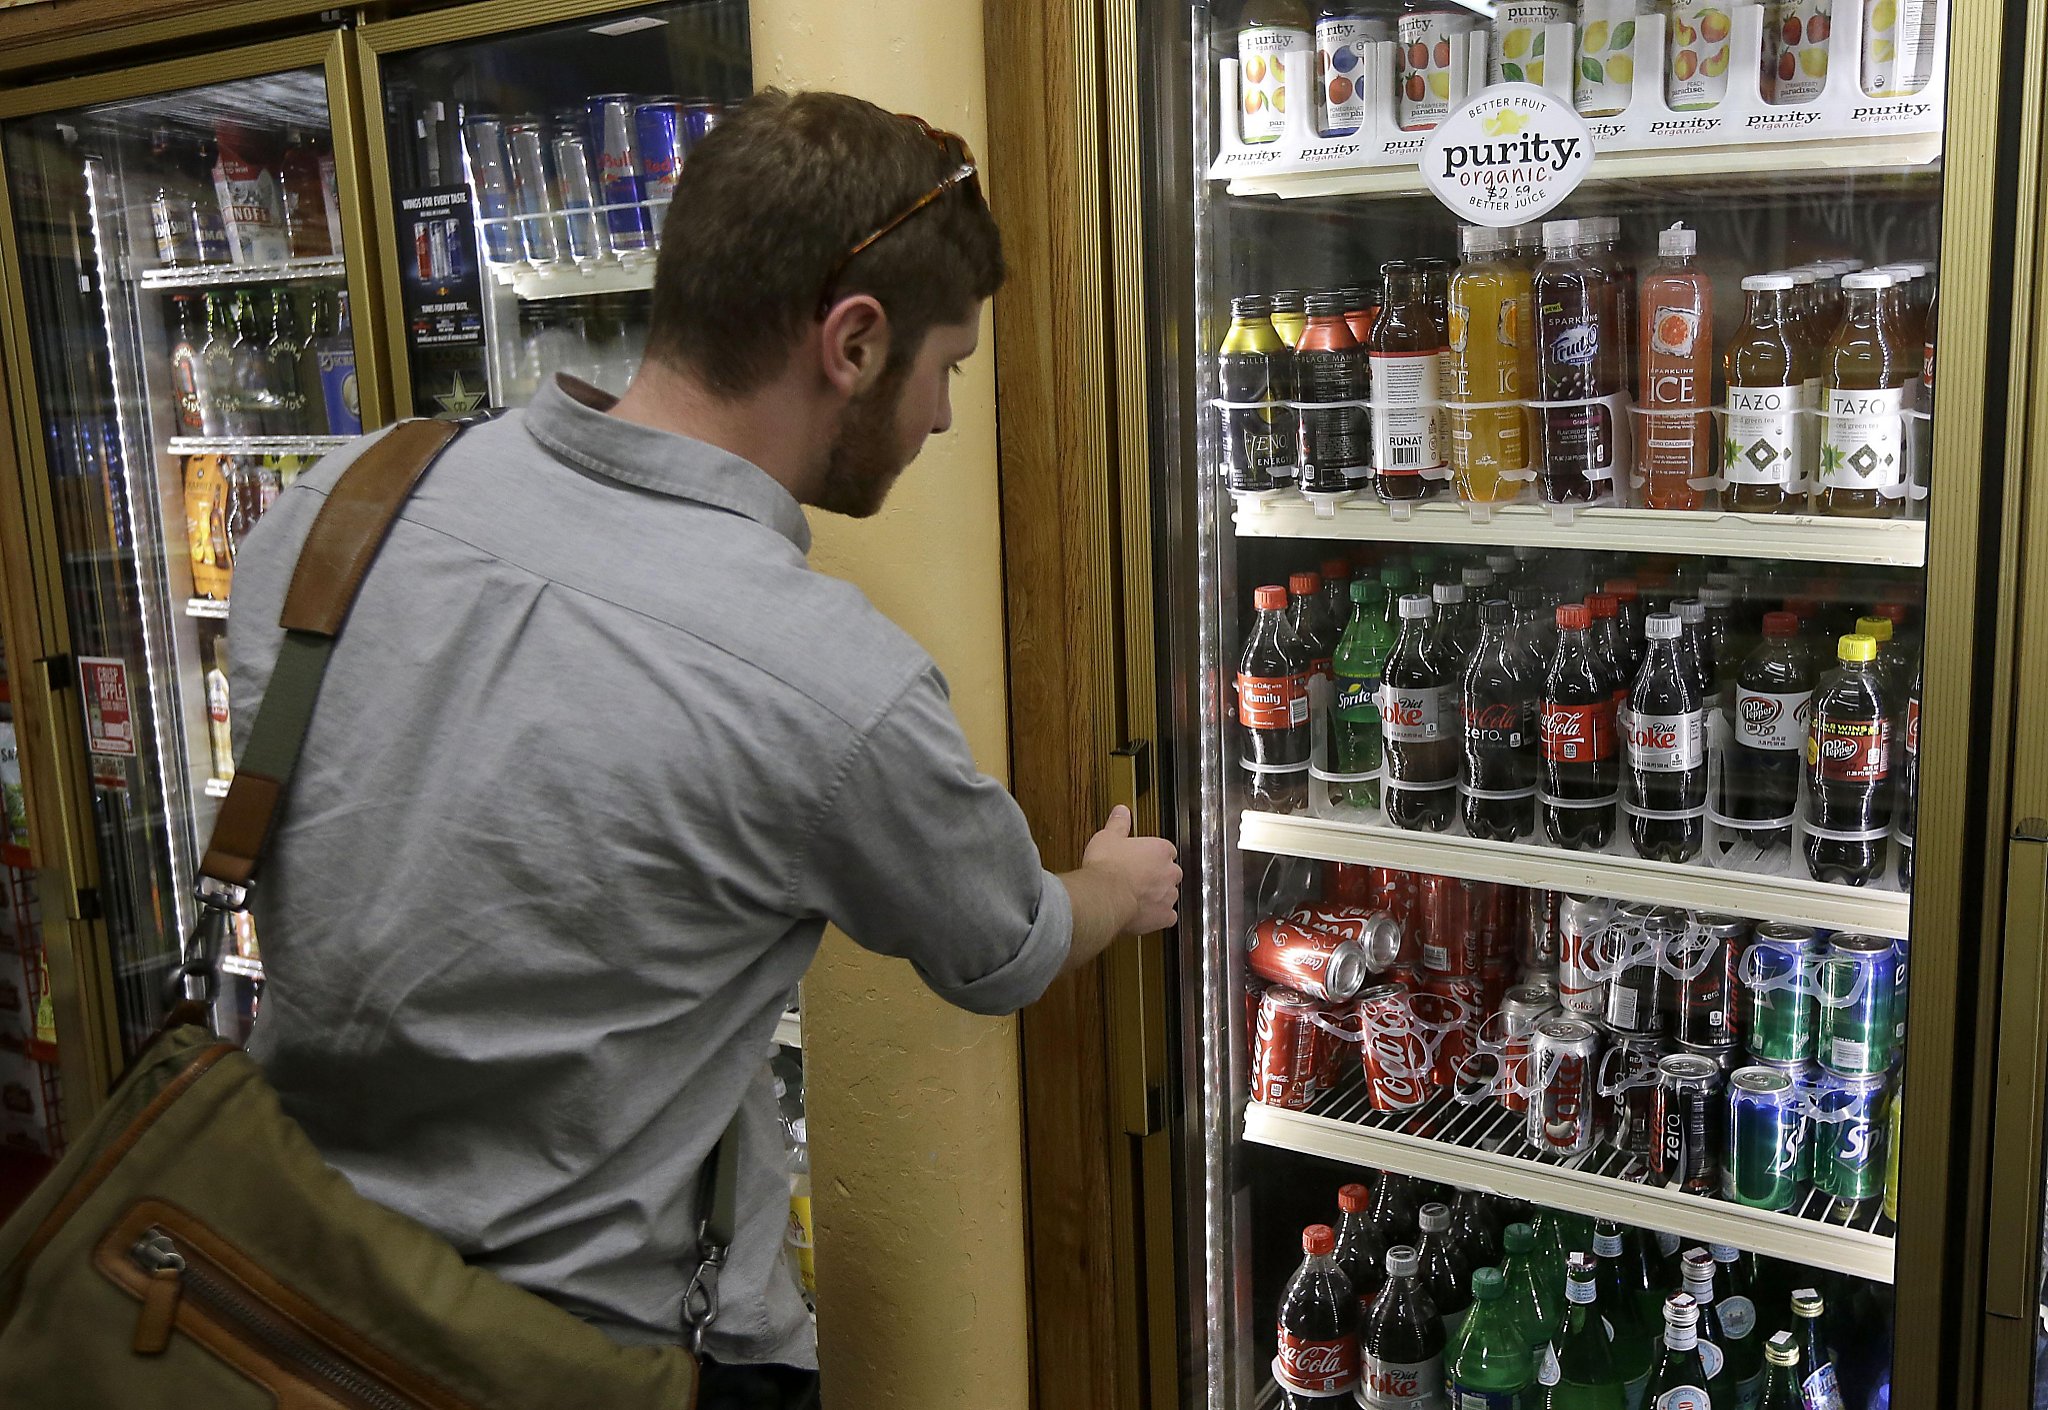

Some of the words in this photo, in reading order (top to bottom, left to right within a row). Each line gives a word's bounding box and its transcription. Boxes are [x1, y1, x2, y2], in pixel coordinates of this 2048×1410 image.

[1507, 6, 1560, 20] purity.
[1468, 98, 1510, 119] BETTER
[1514, 97, 1548, 113] FRUIT
[1851, 102, 1932, 120] purity.
[1649, 118, 1722, 132] purity.
[1746, 110, 1822, 126] purity.
[1225, 150, 1282, 164] purity.
[1299, 144, 1360, 160] purity.
[1442, 132, 1581, 178] purity.
[1460, 166, 1552, 188] organic.
[422, 196, 434, 208] FOR
[434, 194, 450, 206] EVERY
[1468, 196, 1510, 211] BETTER
[1514, 189, 1547, 209] JUICE
[1486, 184, 1531, 202] $2.59
[1549, 314, 1598, 326] SPARKLING
[268, 342, 302, 364] SONOMA
[1301, 355, 1328, 364] BLACK
[1650, 376, 1695, 403] ICE
[1732, 394, 1780, 411] TAZO
[1572, 418, 1590, 426] Grape
[100, 683, 124, 700] APPLE
[1245, 690, 1280, 705] Family
[1338, 688, 1371, 710] Sprite
[1399, 698, 1424, 709] Diet
[1744, 702, 1774, 720] Pepper
[1753, 700, 1766, 710] Dr
[1653, 723, 1677, 734] Diet
[1824, 740, 1854, 758] Pepper
[1614, 1072, 1626, 1116] zeo
[1278, 1329, 1344, 1374] Coca-Cola
[1391, 1370, 1418, 1380] Diet
